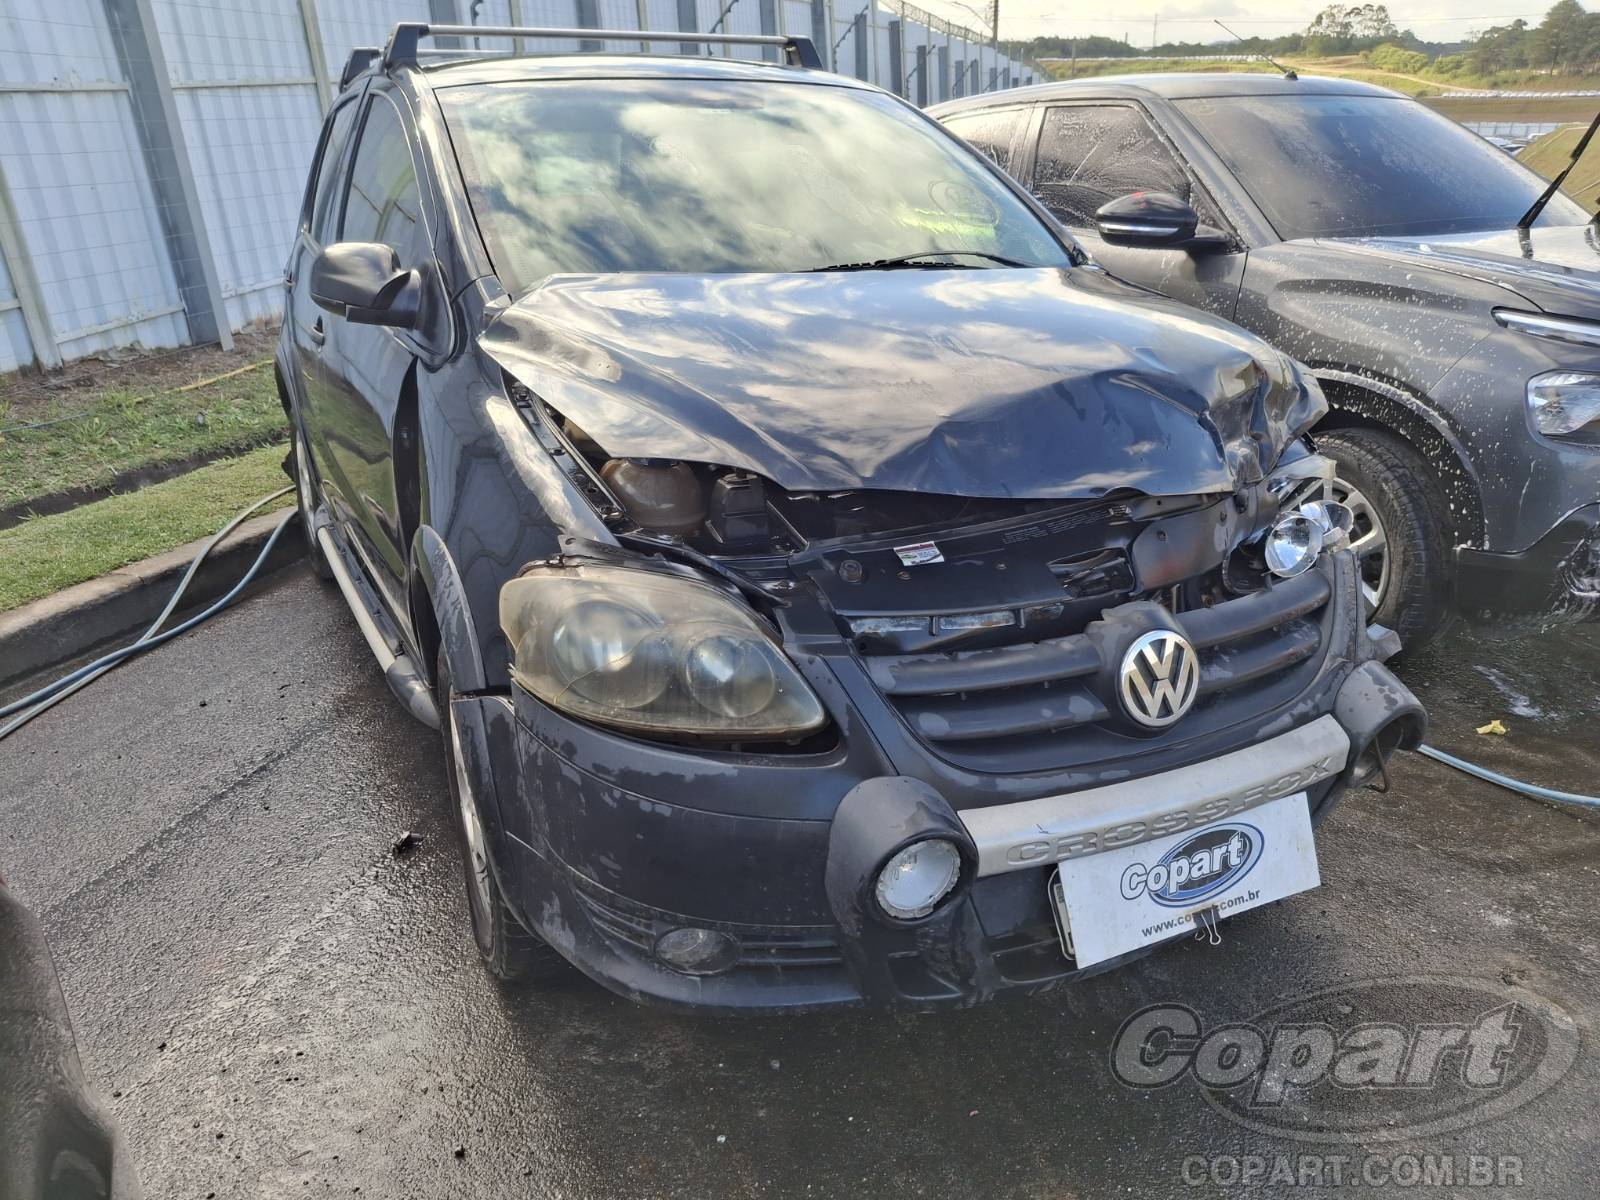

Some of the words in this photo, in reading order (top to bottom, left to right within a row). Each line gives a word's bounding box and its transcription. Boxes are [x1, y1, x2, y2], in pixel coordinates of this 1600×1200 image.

[1125, 635, 1195, 722] VW
[1006, 757, 1331, 865] CROSSFOX
[1120, 829, 1247, 901] Copart
[1141, 889, 1260, 937] www.co.com.br
